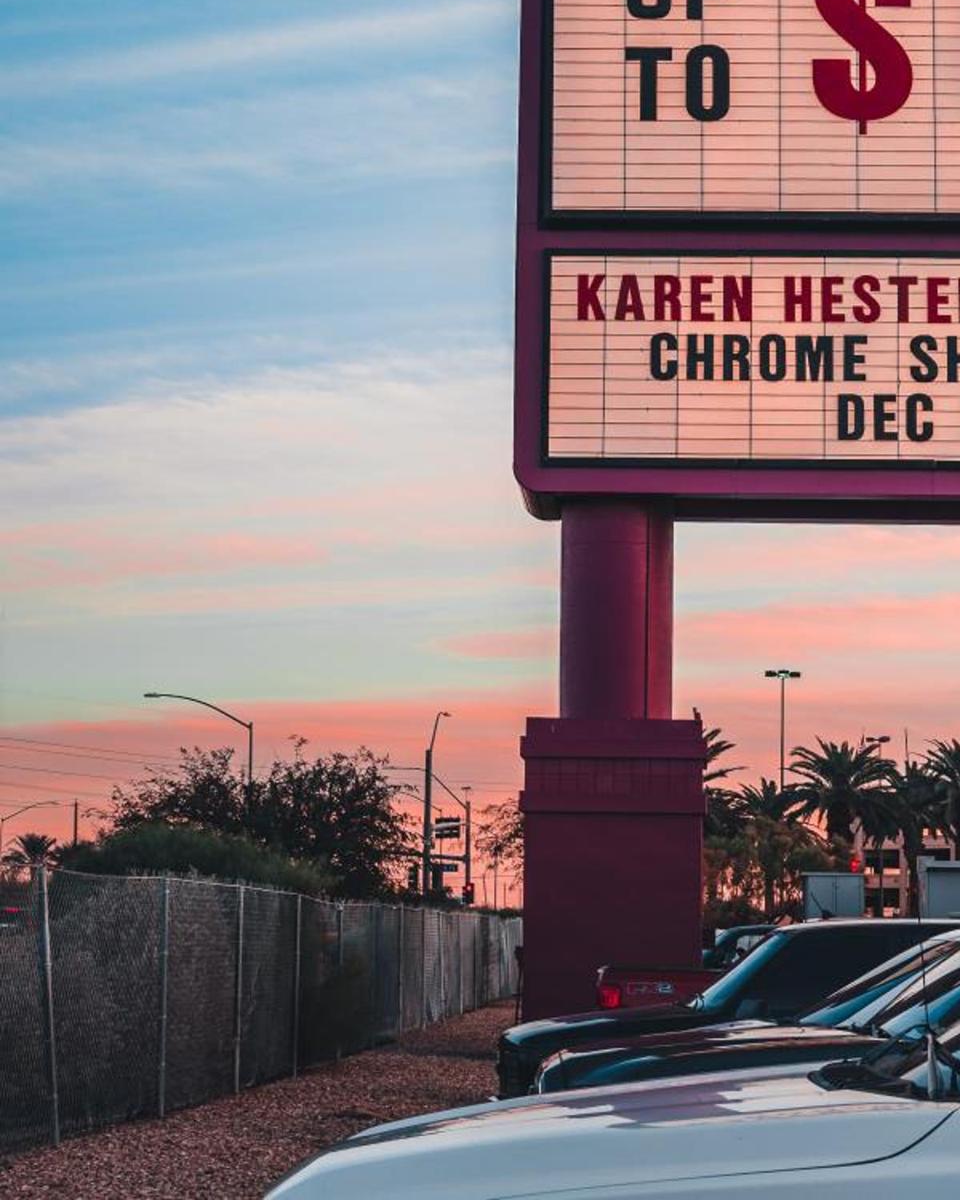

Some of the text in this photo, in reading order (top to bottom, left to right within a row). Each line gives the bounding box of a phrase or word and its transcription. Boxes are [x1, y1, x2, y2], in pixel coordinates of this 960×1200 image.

[625, 44, 730, 122] TO
[577, 274, 753, 323] KAREN
[649, 333, 868, 382] CHROME
[838, 393, 934, 442] DEC
